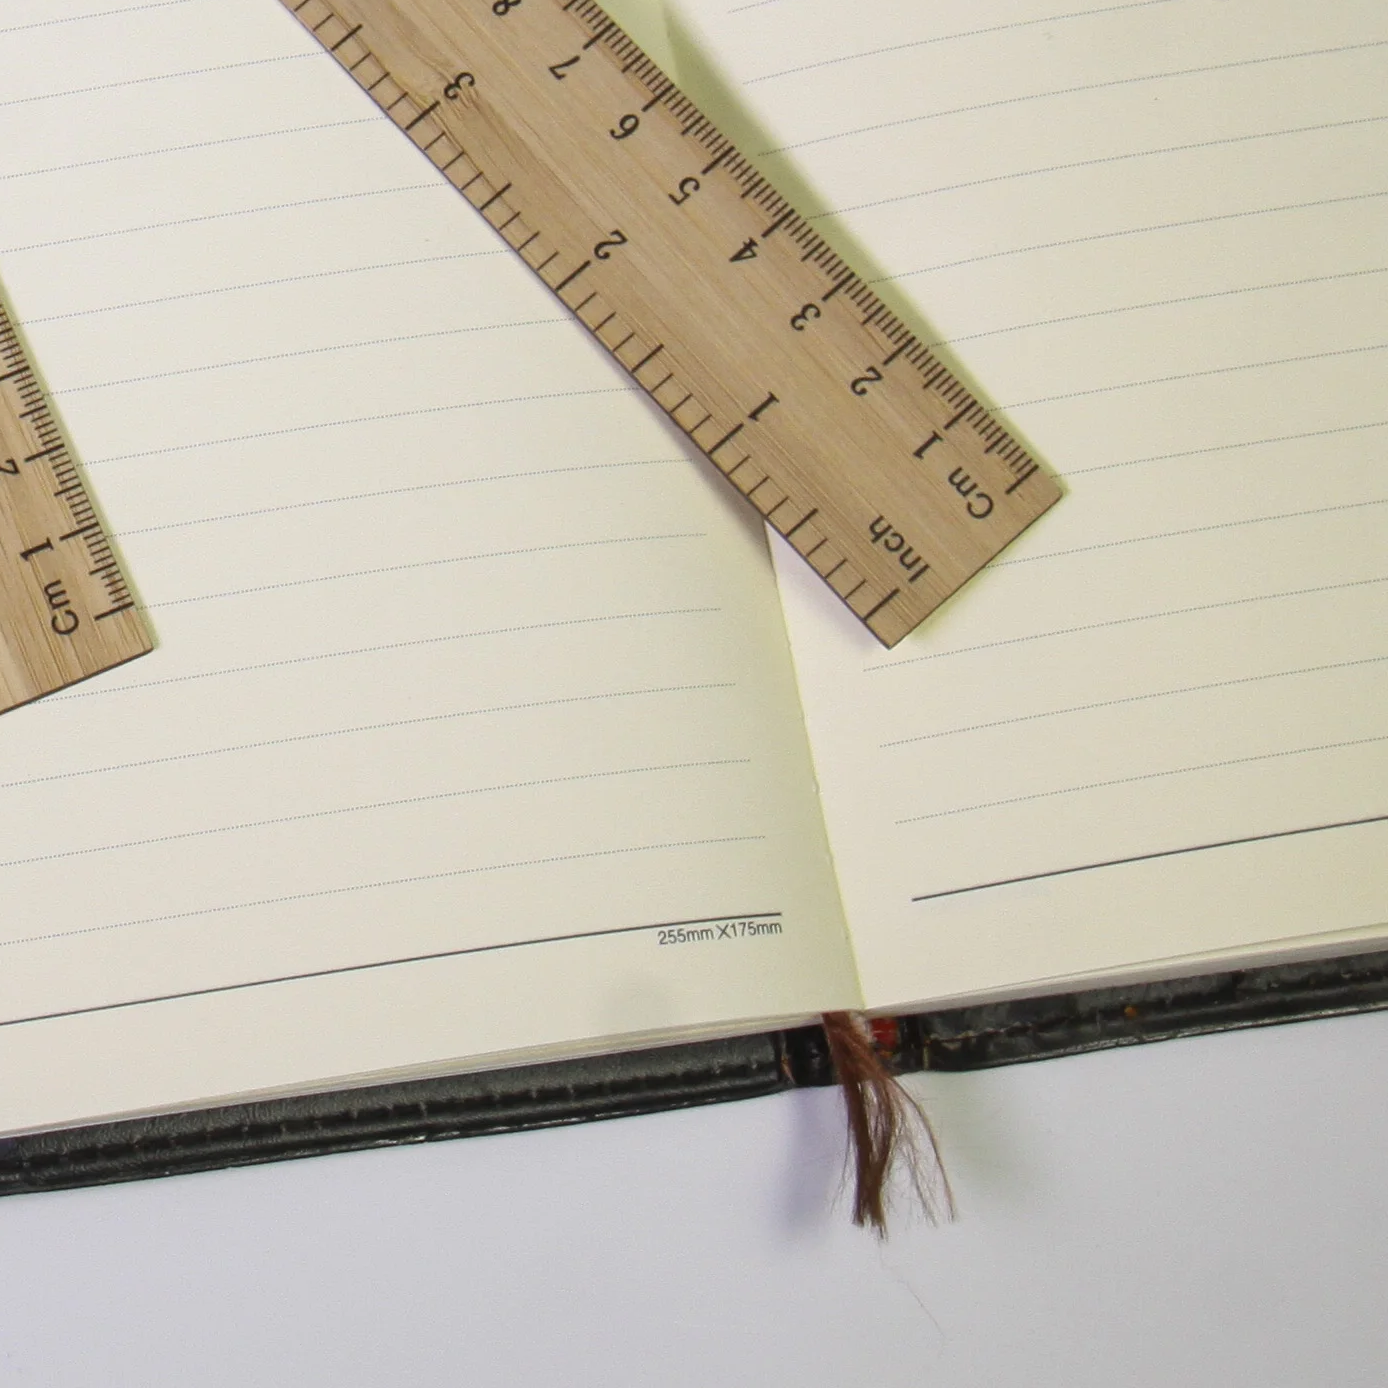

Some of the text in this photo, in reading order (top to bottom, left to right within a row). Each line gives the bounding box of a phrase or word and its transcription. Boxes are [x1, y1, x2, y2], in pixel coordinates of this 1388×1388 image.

[548, 55, 580, 80] 7
[443, 72, 476, 101] 3
[610, 114, 639, 141] 6
[668, 177, 700, 206] 5
[594, 229, 628, 260] 2
[729, 237, 758, 262] 4
[790, 303, 821, 331] 3
[850, 366, 883, 396] 2
[747, 392, 779, 422] 1
[913, 430, 943, 459] 1
[947, 467, 995, 520] Cm
[20, 537, 54, 562] 1
[868, 515, 932, 584] Inch
[44, 579, 80, 636] Cm
